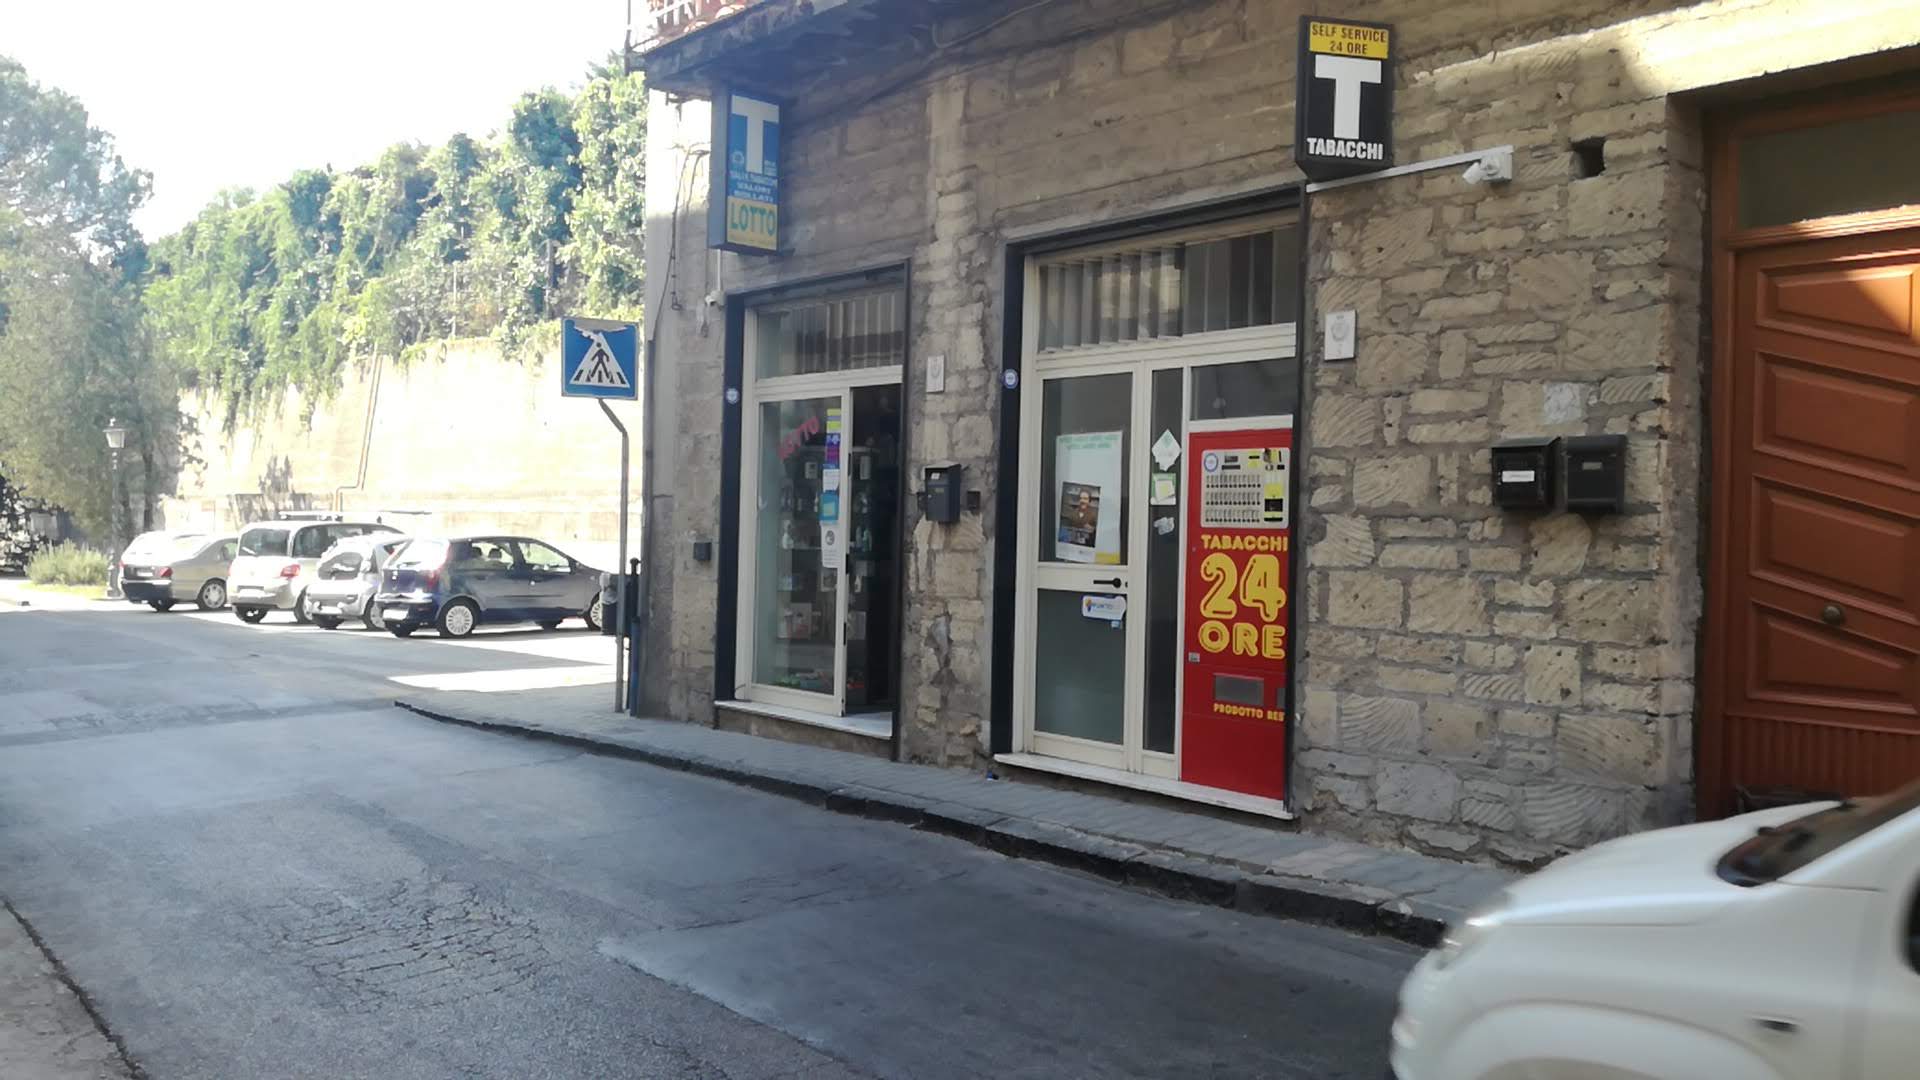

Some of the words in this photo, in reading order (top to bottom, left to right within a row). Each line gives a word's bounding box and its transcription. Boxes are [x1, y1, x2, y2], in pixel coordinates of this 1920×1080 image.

[1312, 24, 1337, 37] SELF
[1341, 27, 1387, 43] SERVICE
[1330, 40, 1343, 53] 24
[1347, 42, 1368, 55] ORE
[1315, 54, 1382, 140] T
[731, 95, 779, 174] T
[1306, 137, 1384, 160] TABACCHI
[729, 202, 776, 237] LOTTO
[1201, 534, 1289, 552] TABACCHI
[1200, 552, 1287, 623] 24
[1198, 620, 1286, 660] ORE
[1213, 702, 1264, 719] PRODOTTO
